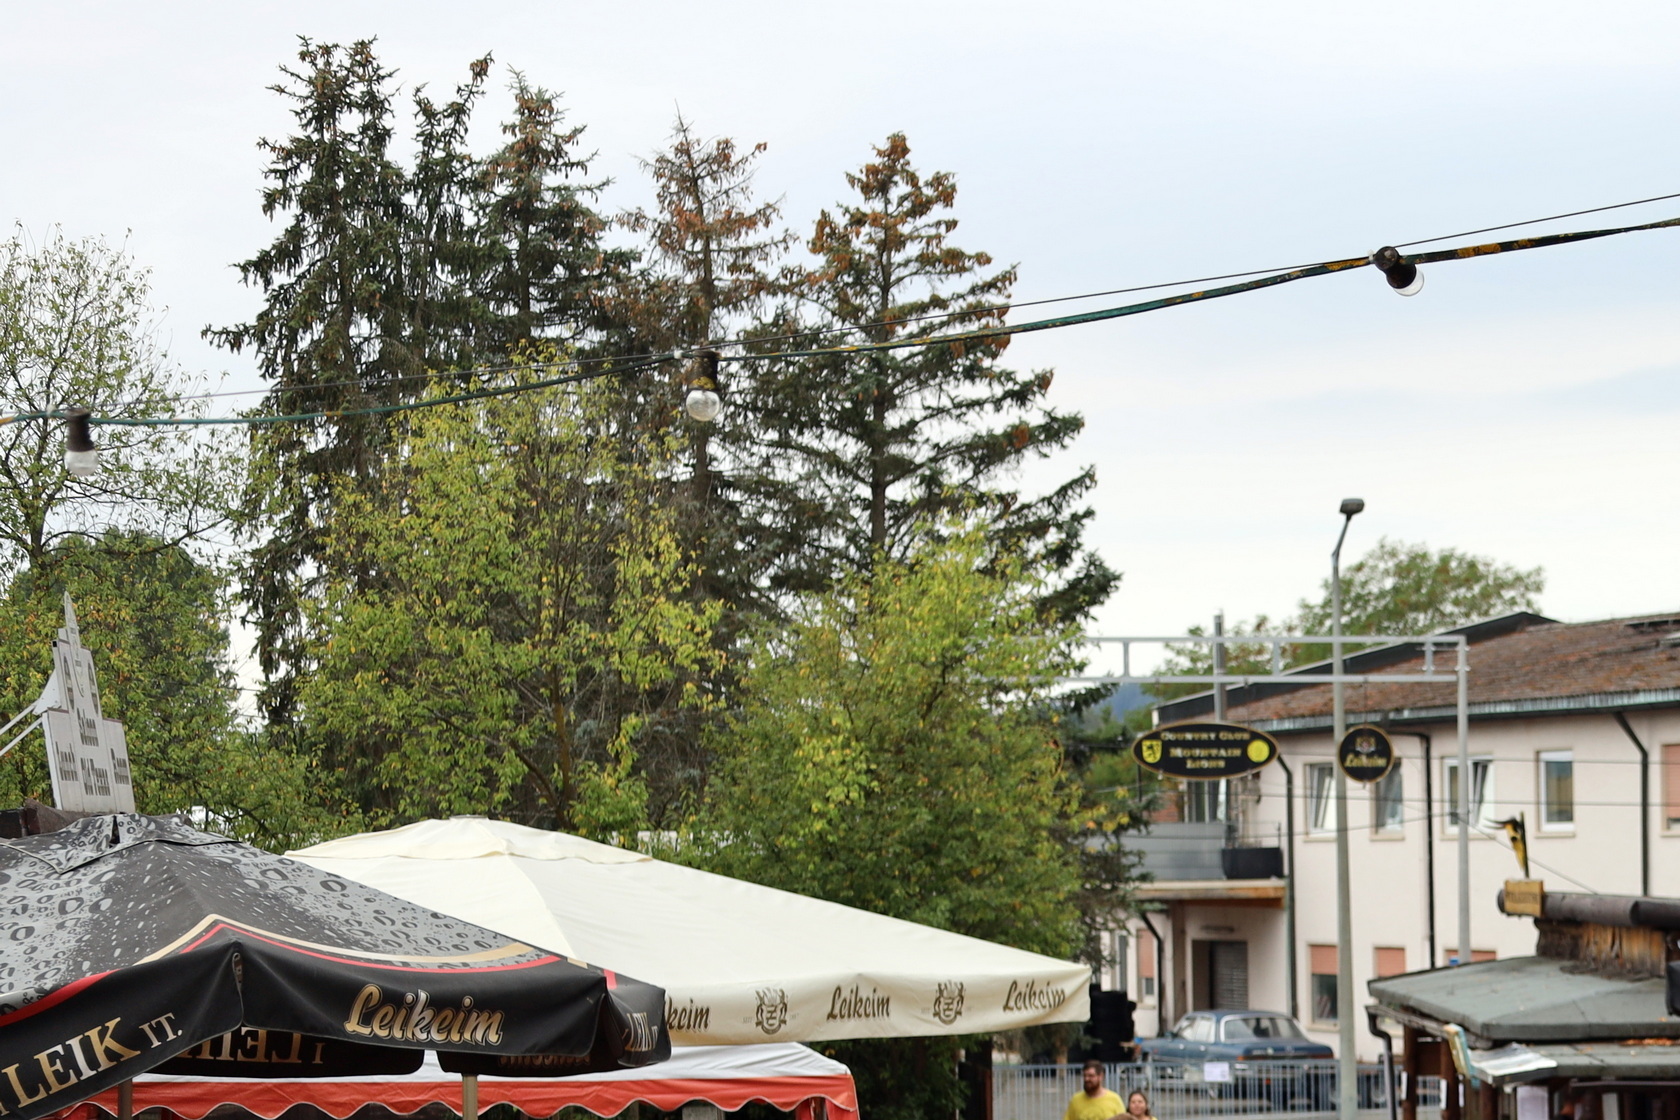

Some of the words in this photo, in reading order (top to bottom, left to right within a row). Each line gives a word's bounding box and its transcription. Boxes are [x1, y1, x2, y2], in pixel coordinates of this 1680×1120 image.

[666, 996, 711, 1031] keim
[827, 985, 891, 1022] Leikeim
[1003, 979, 1066, 1013] Leikeim
[344, 984, 504, 1046] Leikeim
[2, 1017, 141, 1109] LEIK
[138, 1012, 183, 1049] IT.
